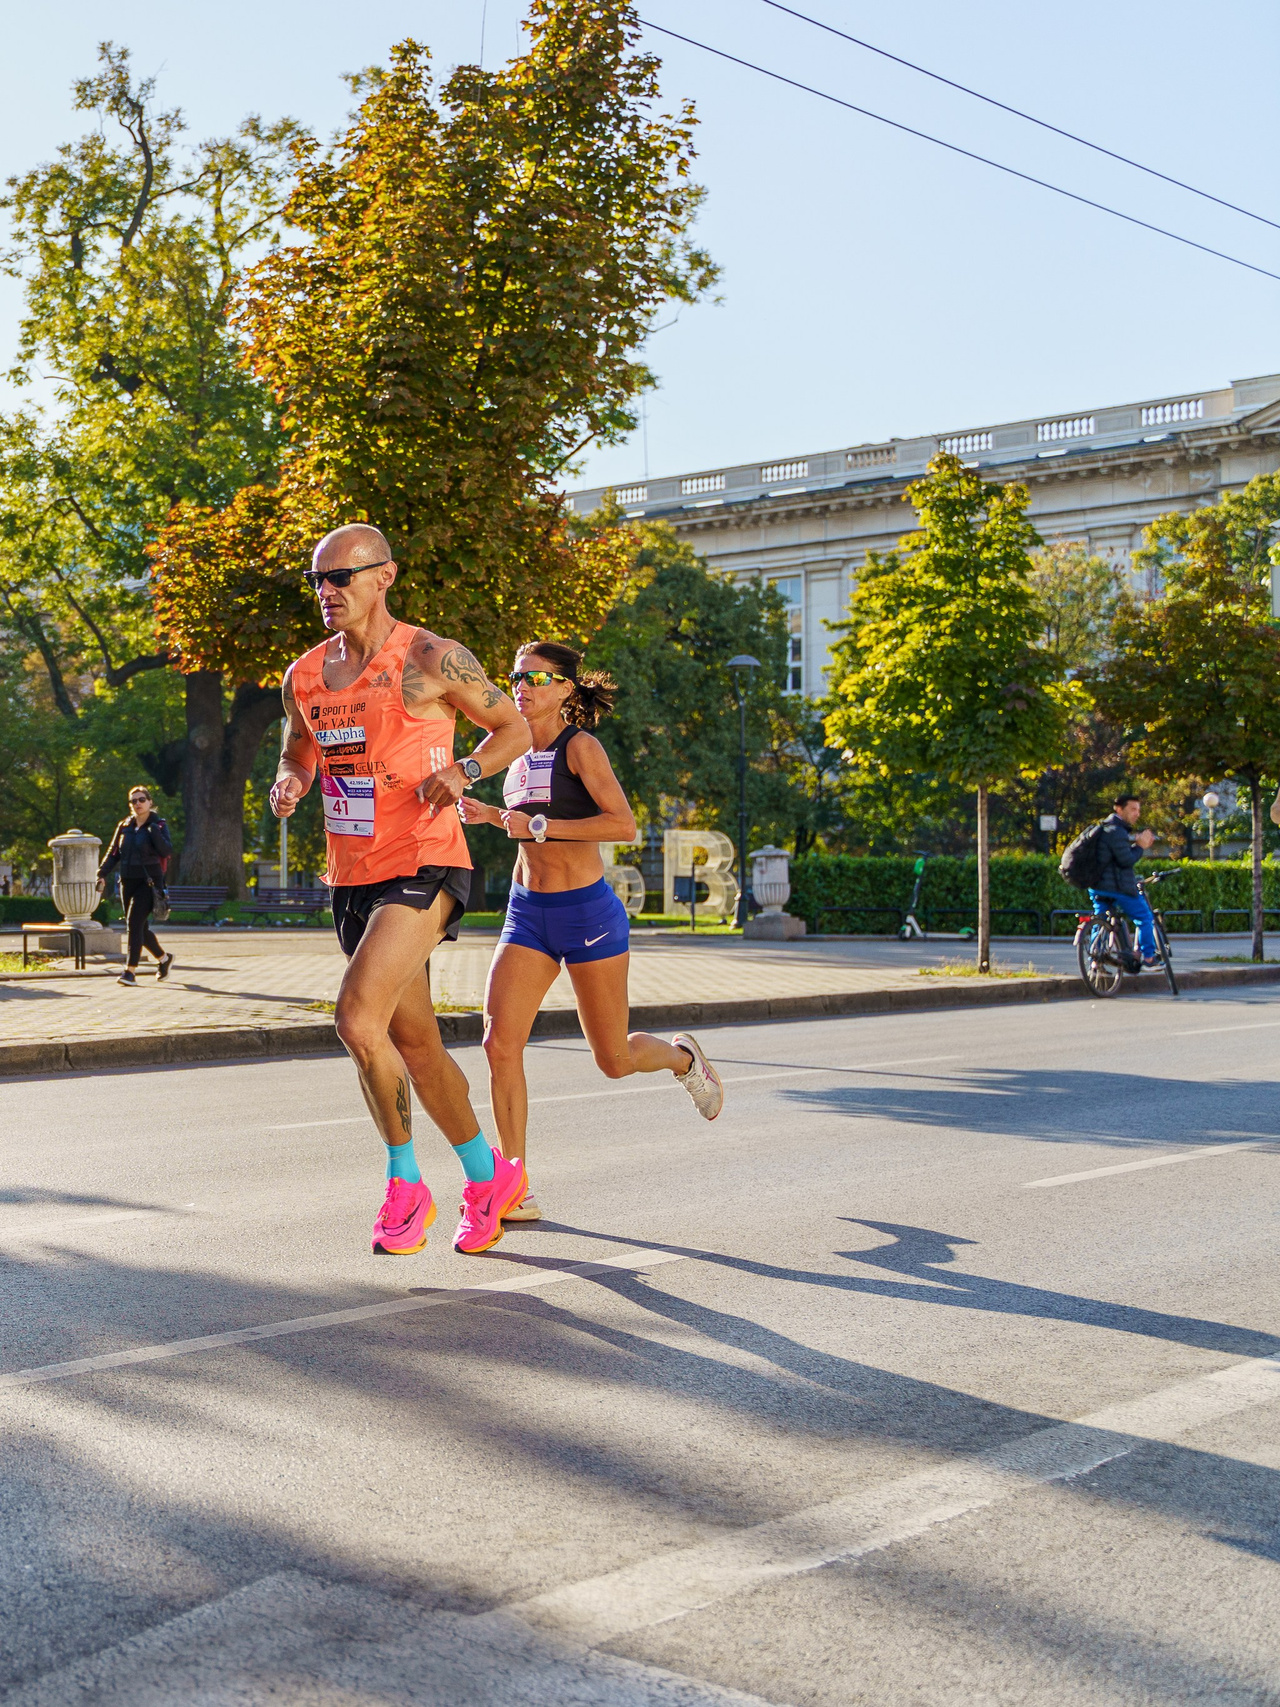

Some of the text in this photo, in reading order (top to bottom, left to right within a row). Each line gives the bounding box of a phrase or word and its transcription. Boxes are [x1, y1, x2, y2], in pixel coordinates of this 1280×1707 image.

[318, 716, 356, 731] Dr VAIS
[519, 774, 527, 788] 9
[332, 799, 349, 816] 41
